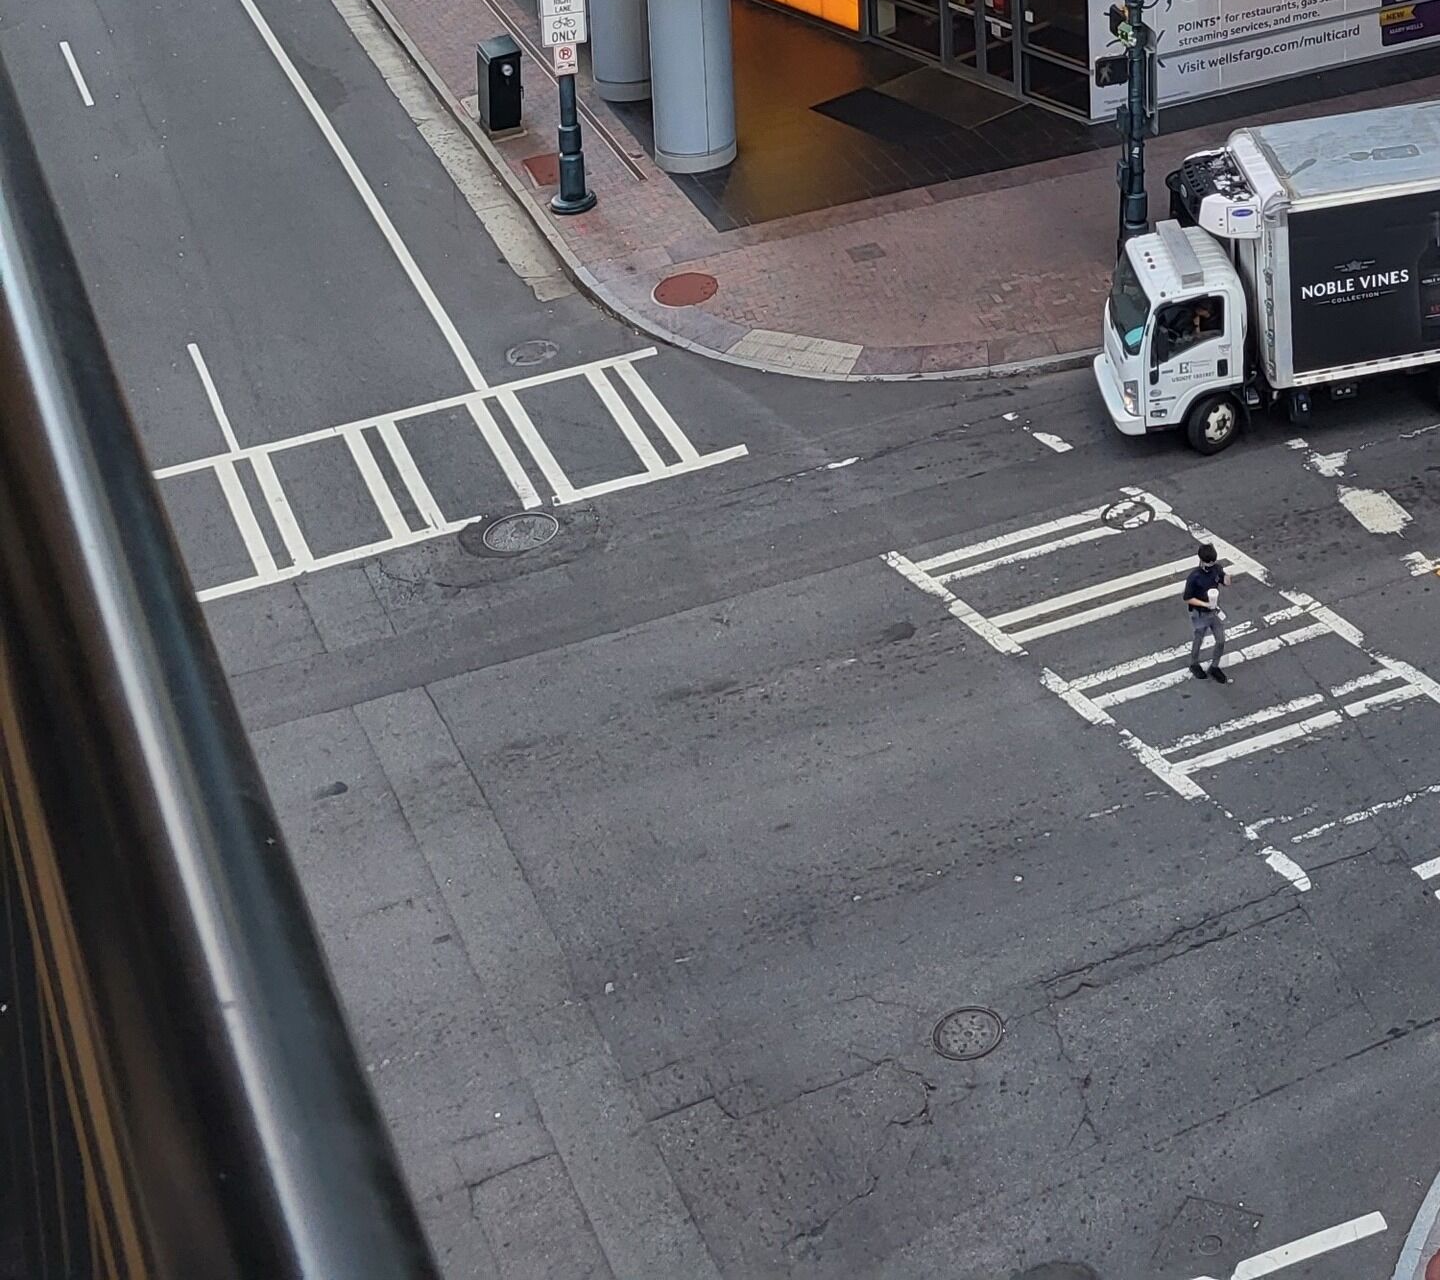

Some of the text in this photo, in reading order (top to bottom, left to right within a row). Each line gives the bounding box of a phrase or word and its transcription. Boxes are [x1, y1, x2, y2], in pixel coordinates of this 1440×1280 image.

[554, 5, 572, 13] LANE
[1224, 13, 1240, 24] for
[1241, 1, 1300, 20] restaurants,
[551, 30, 577, 43] ONLY
[1178, 9, 1320, 47] streaming services, and more.
[1177, 24, 1360, 75] Visit wellsfargo.com/multicard
[1301, 278, 1355, 300] NOBLE
[1359, 269, 1410, 289] VINES
[1331, 291, 1380, 304] COLLECTION
